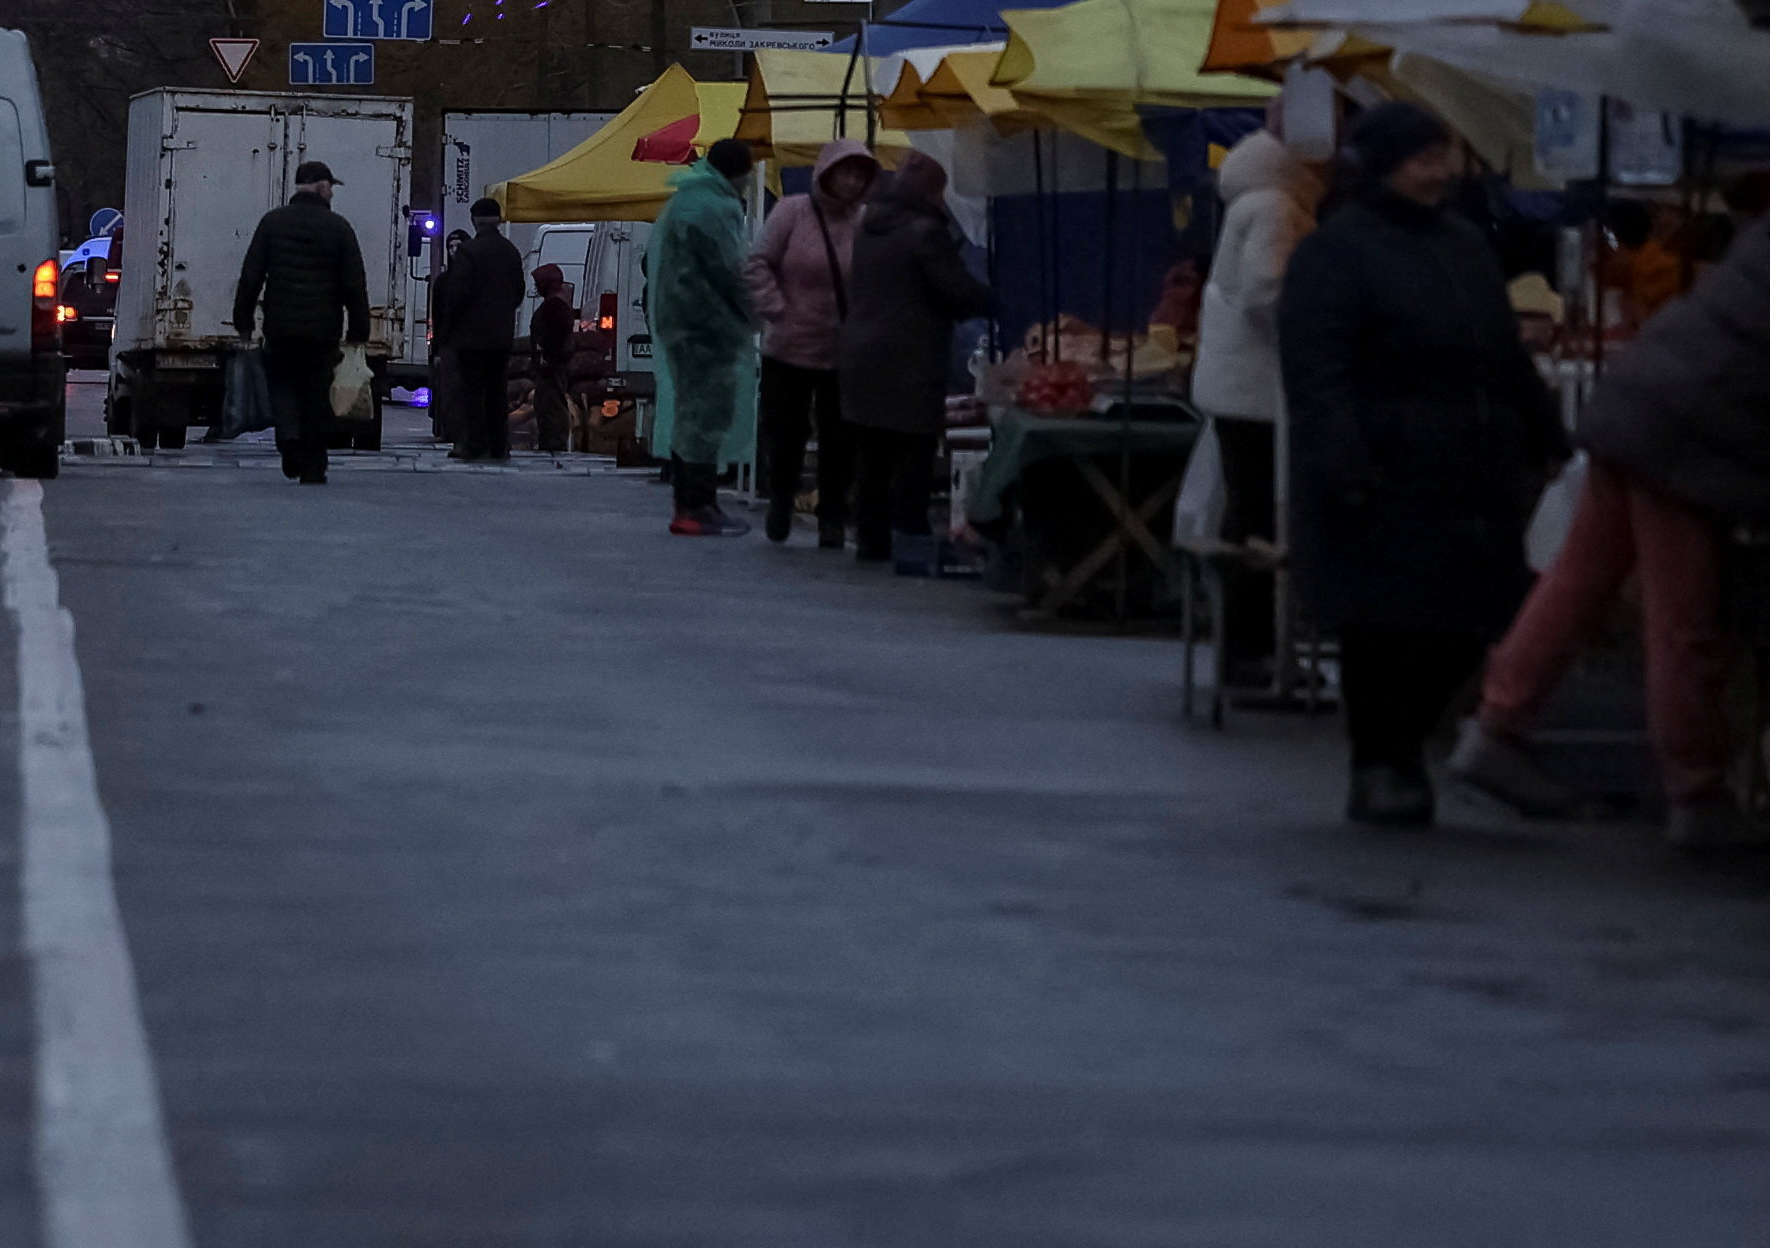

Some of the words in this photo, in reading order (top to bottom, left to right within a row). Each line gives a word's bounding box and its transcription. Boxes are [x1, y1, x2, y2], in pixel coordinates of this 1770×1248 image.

[709, 40, 746, 48] МИКОЛИ
[749, 40, 816, 50] ЗАКРЕВСЬКОГО
[456, 158, 464, 203] SCHMITZ
